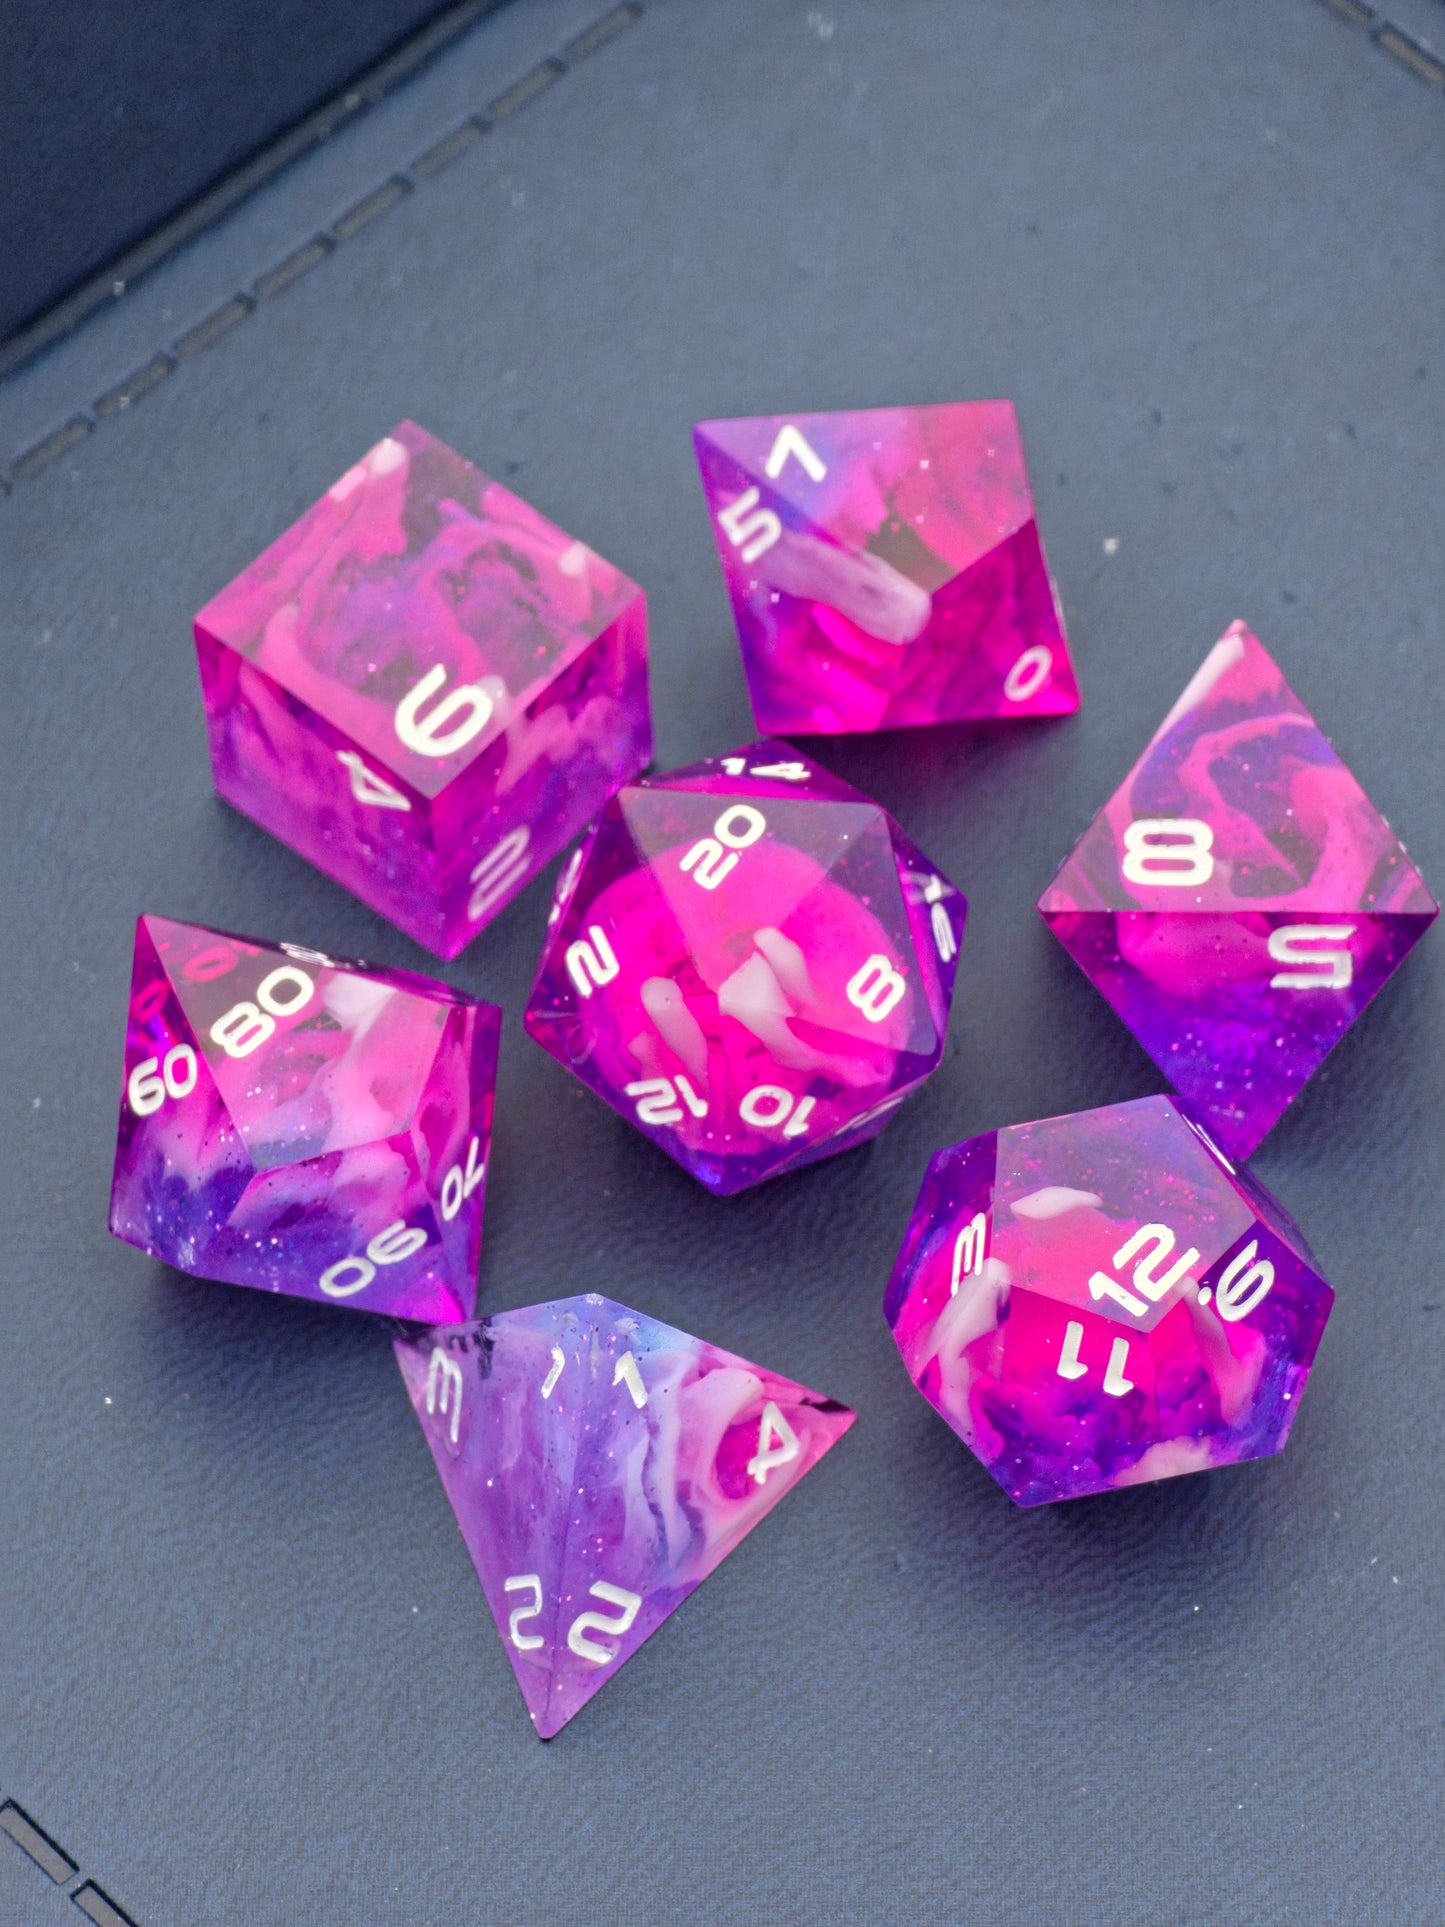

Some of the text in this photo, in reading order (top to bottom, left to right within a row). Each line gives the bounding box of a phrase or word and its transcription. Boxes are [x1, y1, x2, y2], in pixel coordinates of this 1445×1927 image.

[765, 424, 828, 483] 7
[717, 485, 781, 564] 5
[394, 663, 494, 757] 6
[1003, 644, 1053, 702] 0
[338, 750, 411, 812] 4
[679, 804, 766, 890] 20
[1122, 819, 1215, 886] 8
[565, 925, 620, 997] 2
[846, 953, 906, 1023] 8
[210, 965, 315, 1059] 80
[128, 1043, 198, 1117] 60
[624, 1075, 708, 1125] 12
[739, 1084, 817, 1138] 10
[441, 1136, 484, 1221] 70
[951, 1212, 986, 1298] 3
[1088, 1223, 1200, 1317] 12
[540, 1346, 566, 1399] 1
[612, 1350, 648, 1410] 1
[1056, 1320, 1134, 1396] 11
[426, 1347, 463, 1444] 3
[747, 1401, 800, 1485] 4
